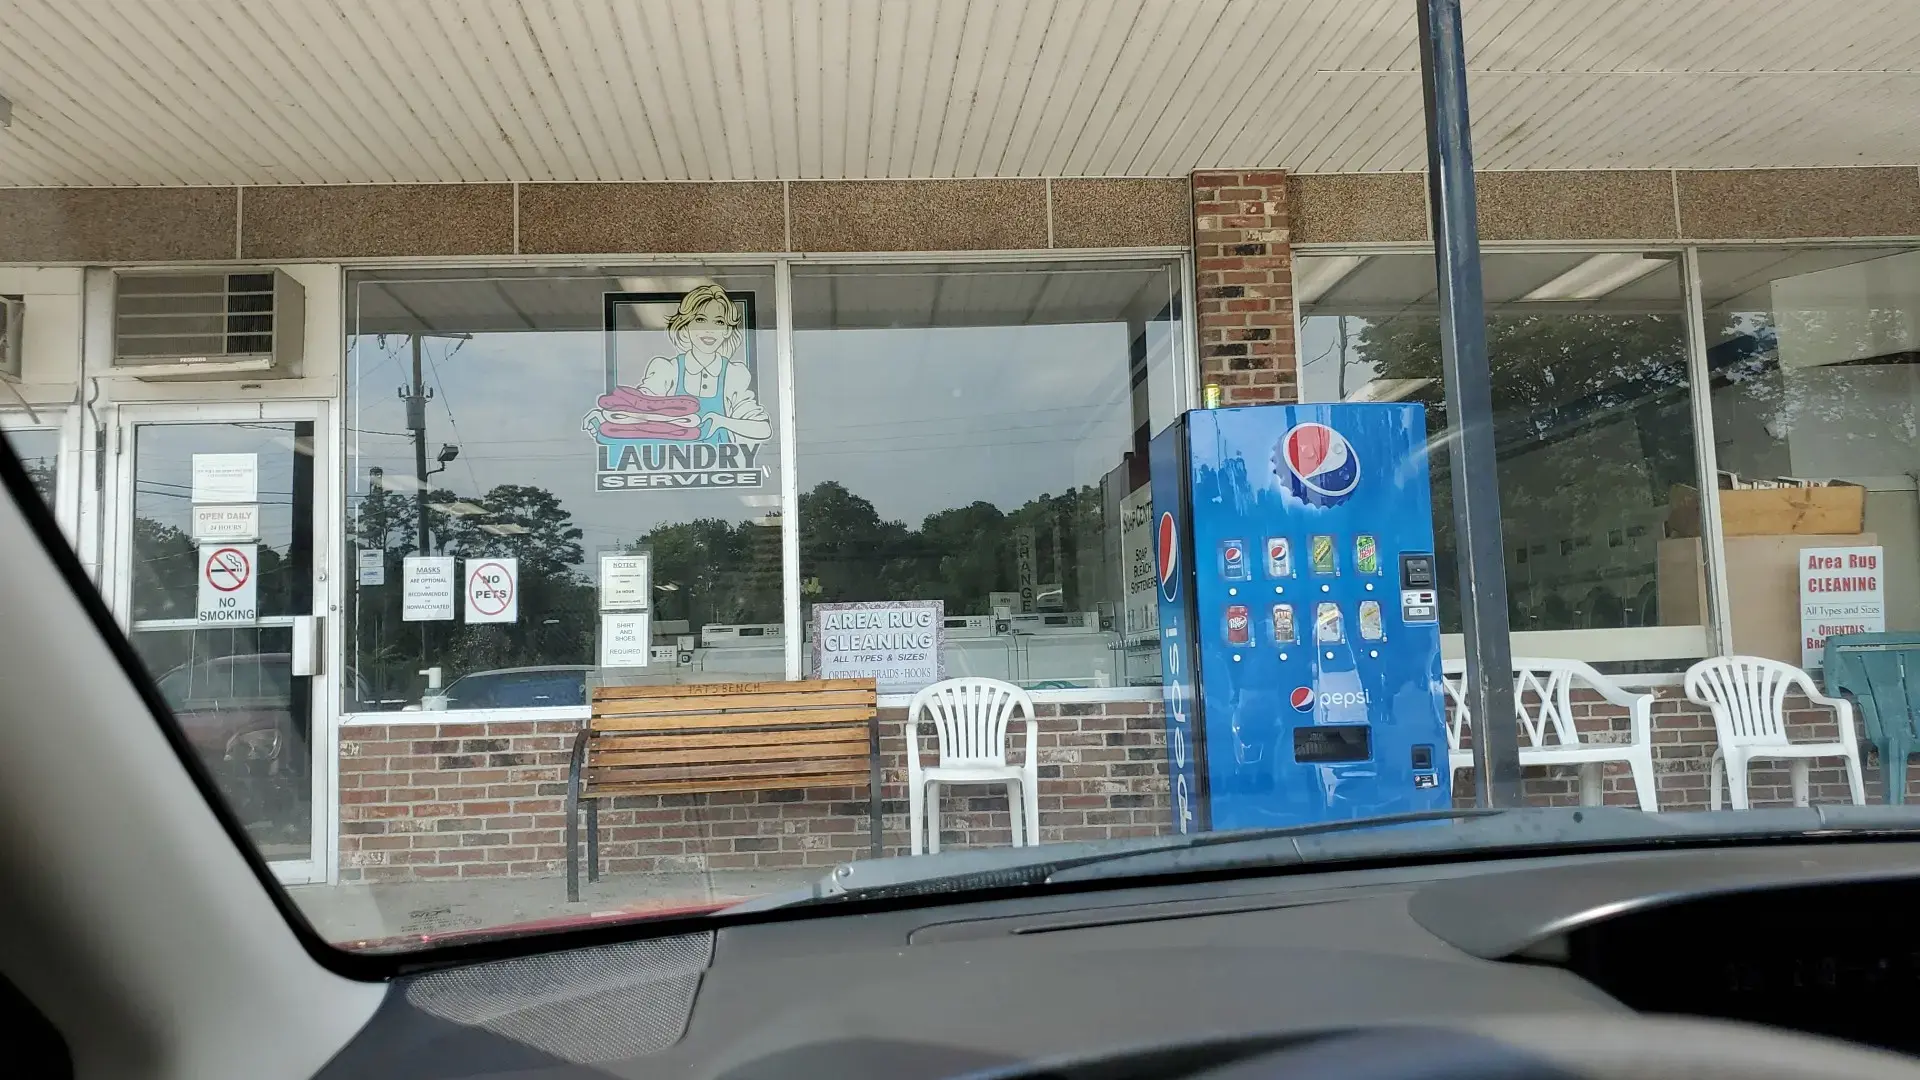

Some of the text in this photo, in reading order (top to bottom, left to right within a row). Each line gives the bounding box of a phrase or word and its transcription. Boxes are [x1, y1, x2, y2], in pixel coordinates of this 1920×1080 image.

[598, 443, 761, 471] LAUNDRY
[602, 473, 757, 488] SERVICE
[199, 511, 253, 520] OPEN DAILY
[1135, 547, 1148, 562] SOAP
[1808, 554, 1877, 569] Area Rug
[1018, 534, 1032, 613] CHANGE
[1134, 562, 1152, 578] BLEACH
[482, 575, 500, 584] NO
[1131, 576, 1157, 594] SOFTENERS
[1808, 577, 1877, 592] CLEANING
[476, 590, 507, 599] PETS
[219, 598, 236, 607] NO
[200, 610, 255, 621] SMOKING
[1806, 605, 1880, 617] All Types and Sizes
[825, 611, 932, 630] AREA RUG
[1818, 624, 1865, 636] ORIENTALS
[824, 632, 933, 652] CLEANING
[1807, 637, 1825, 649] BRA
[854, 654, 883, 662] TYPES
[871, 669, 900, 679] BRAIDS
[904, 667, 931, 677] HOOKS
[722, 682, 761, 692] BENCH
[1320, 688, 1372, 709] pepsi
[1165, 617, 1192, 835] pepsi
